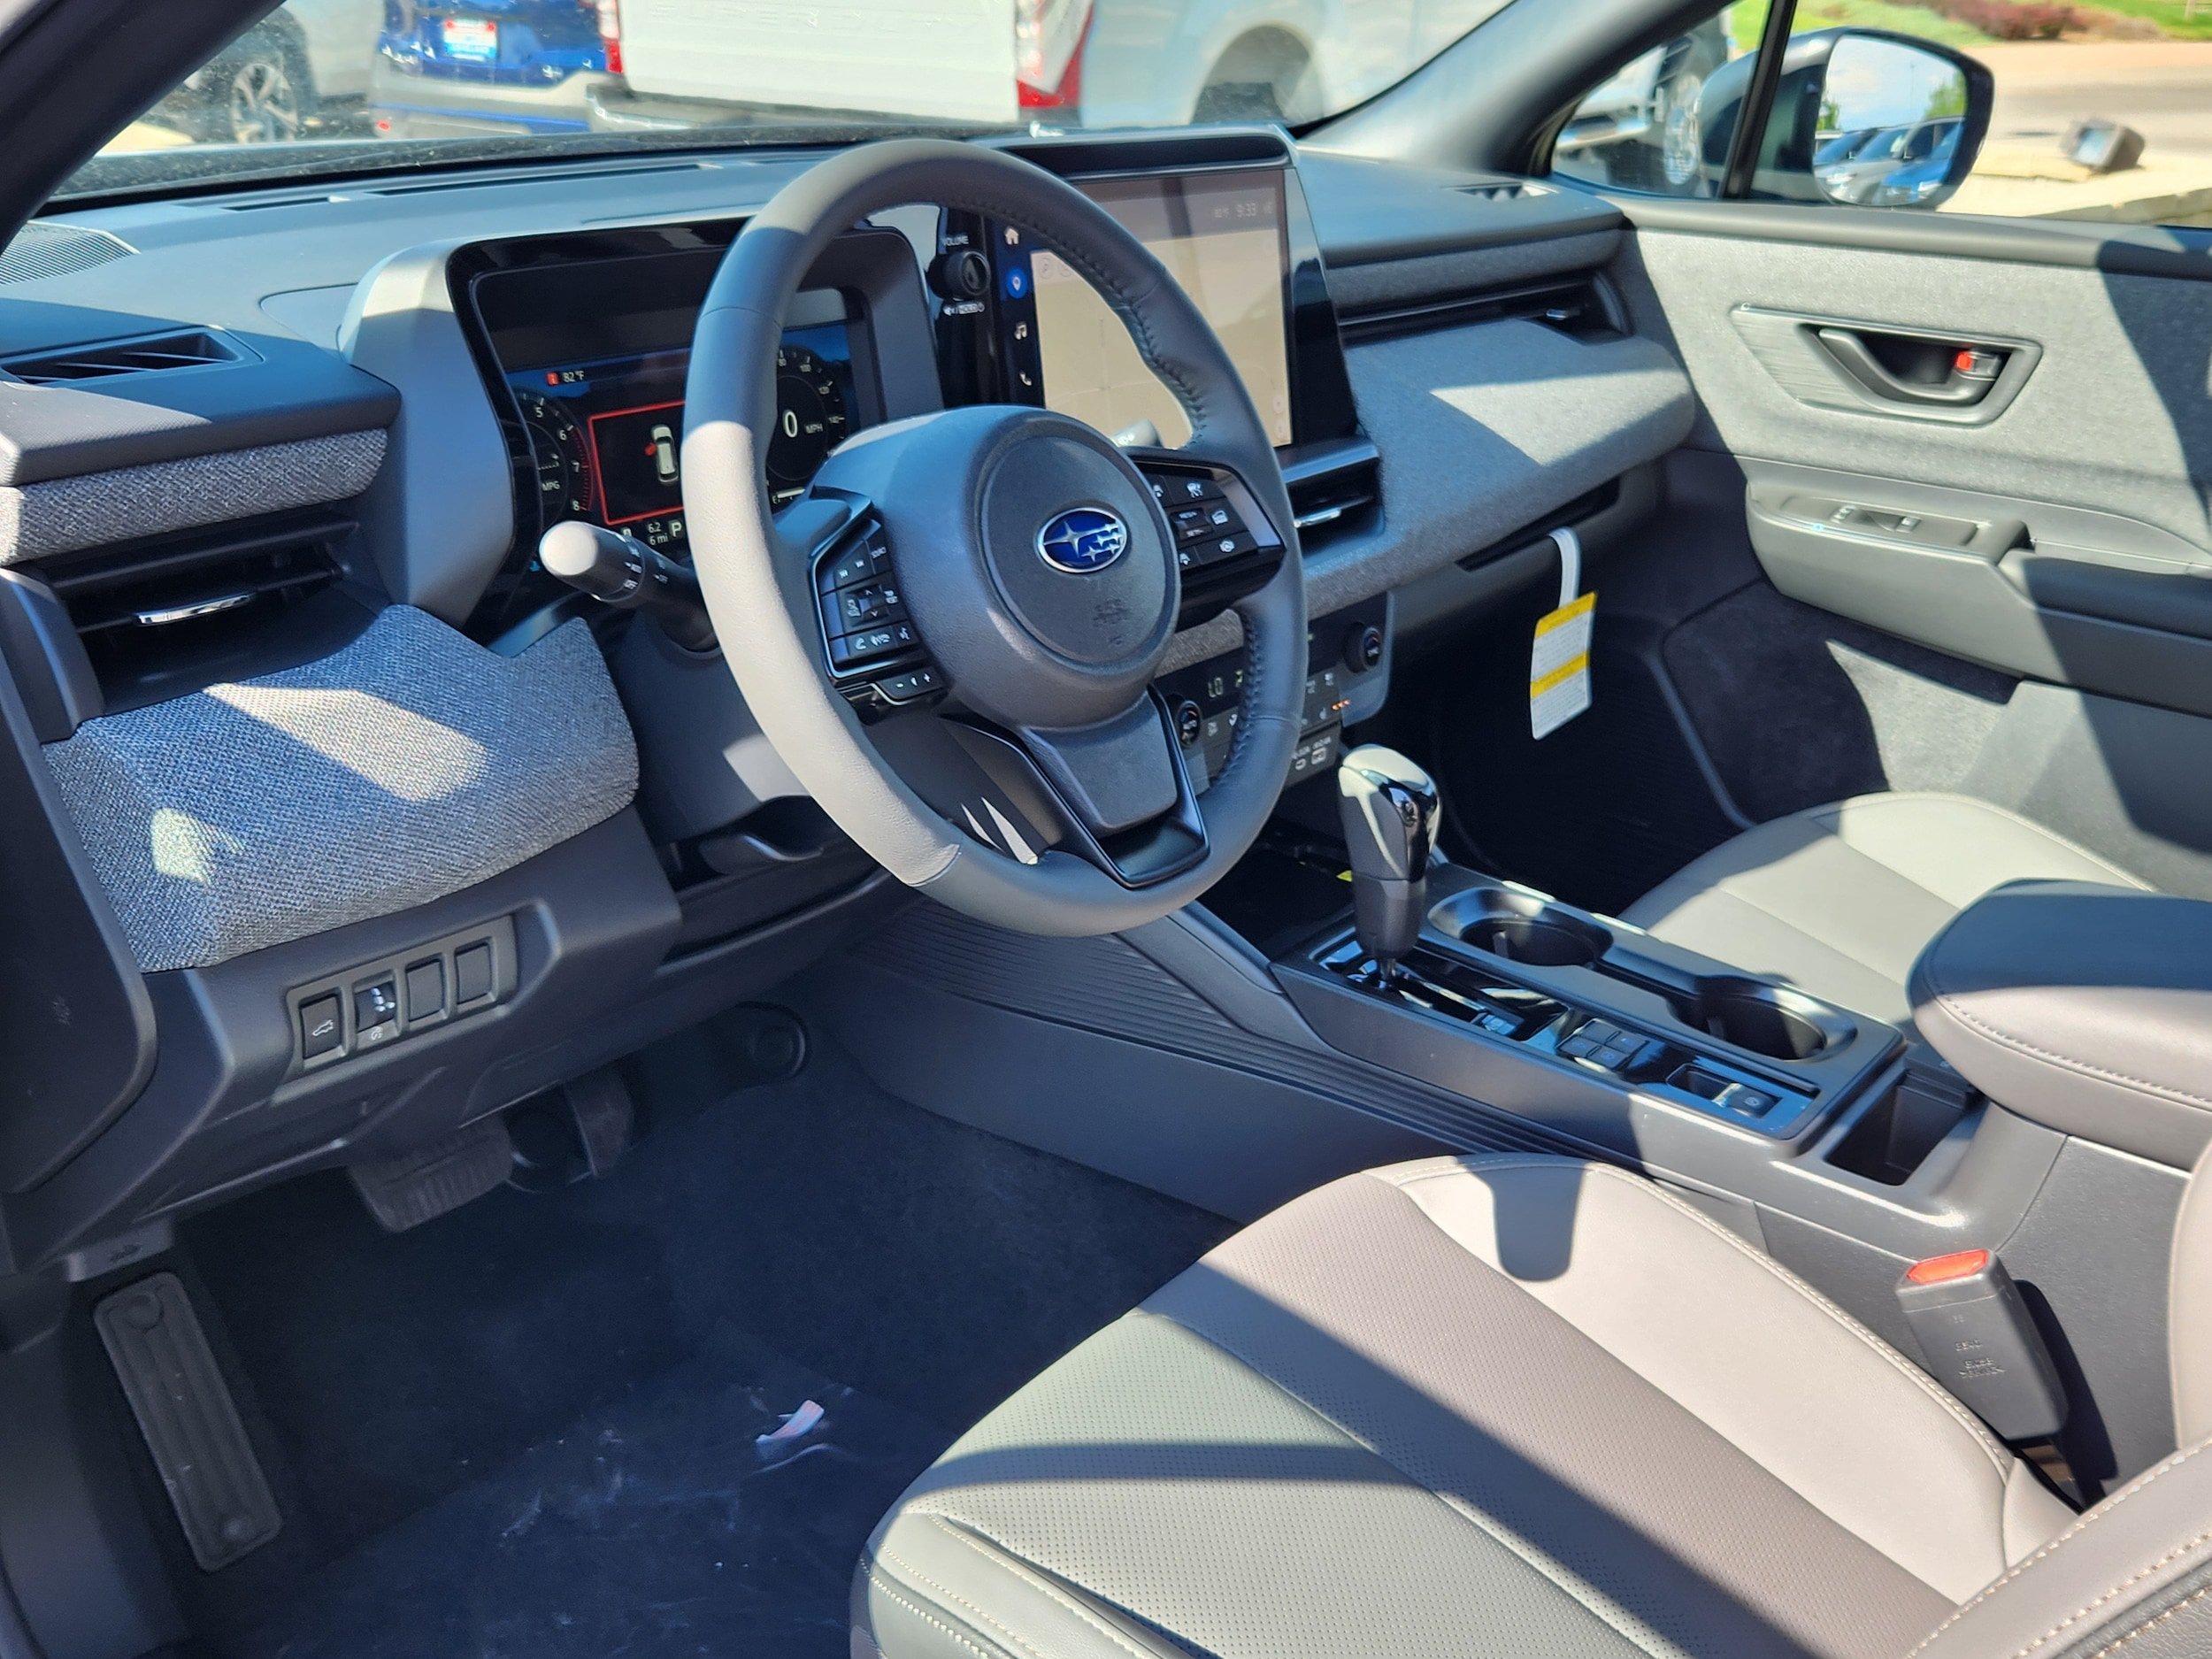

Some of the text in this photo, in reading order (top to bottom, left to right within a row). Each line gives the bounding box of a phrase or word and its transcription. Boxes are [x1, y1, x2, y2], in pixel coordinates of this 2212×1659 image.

[942, 234, 969, 246] VOLUME
[534, 407, 544, 419] 5
[805, 424, 824, 434] MPH
[558, 429, 568, 441] 6
[572, 461, 580, 472] 7
[541, 480, 561, 491] MPG
[572, 500, 580, 511] 8
[671, 521, 682, 537] P
[657, 533, 669, 543] mi
